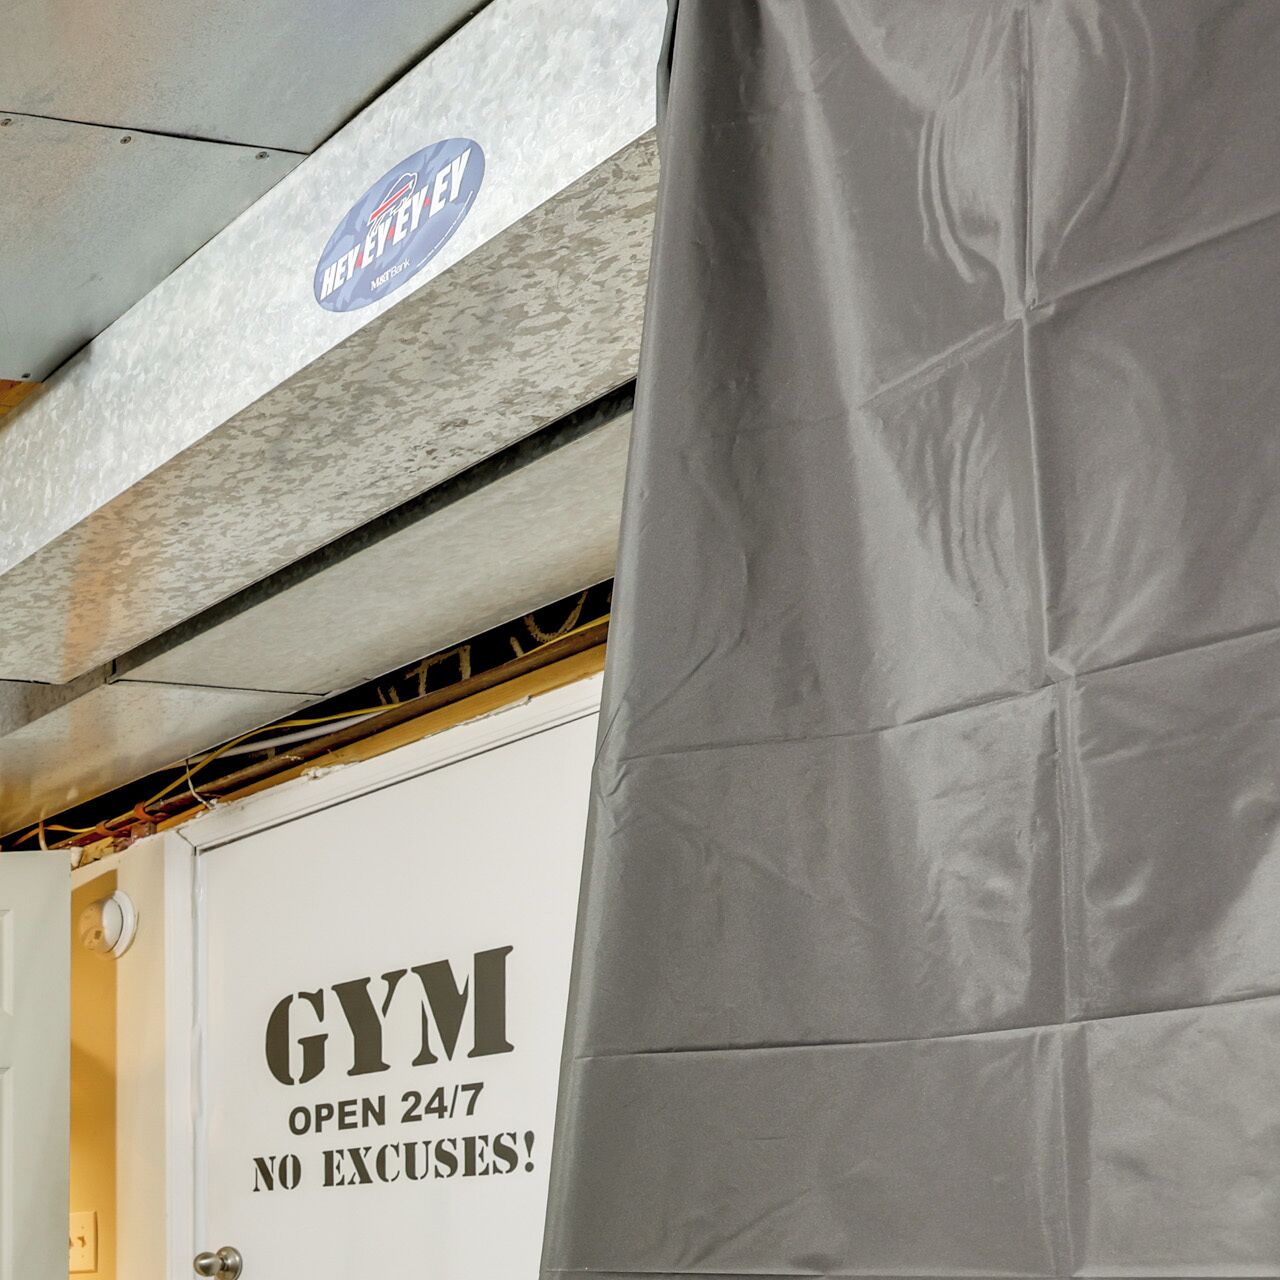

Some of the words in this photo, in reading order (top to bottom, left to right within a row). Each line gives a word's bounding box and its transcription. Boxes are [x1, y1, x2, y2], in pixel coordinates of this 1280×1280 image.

[265, 944, 515, 1086] GYM
[288, 1095, 386, 1135] OPEN
[400, 1081, 485, 1123] 24/7
[252, 1152, 303, 1193] NO
[322, 1129, 536, 1187] EXCUSES!
